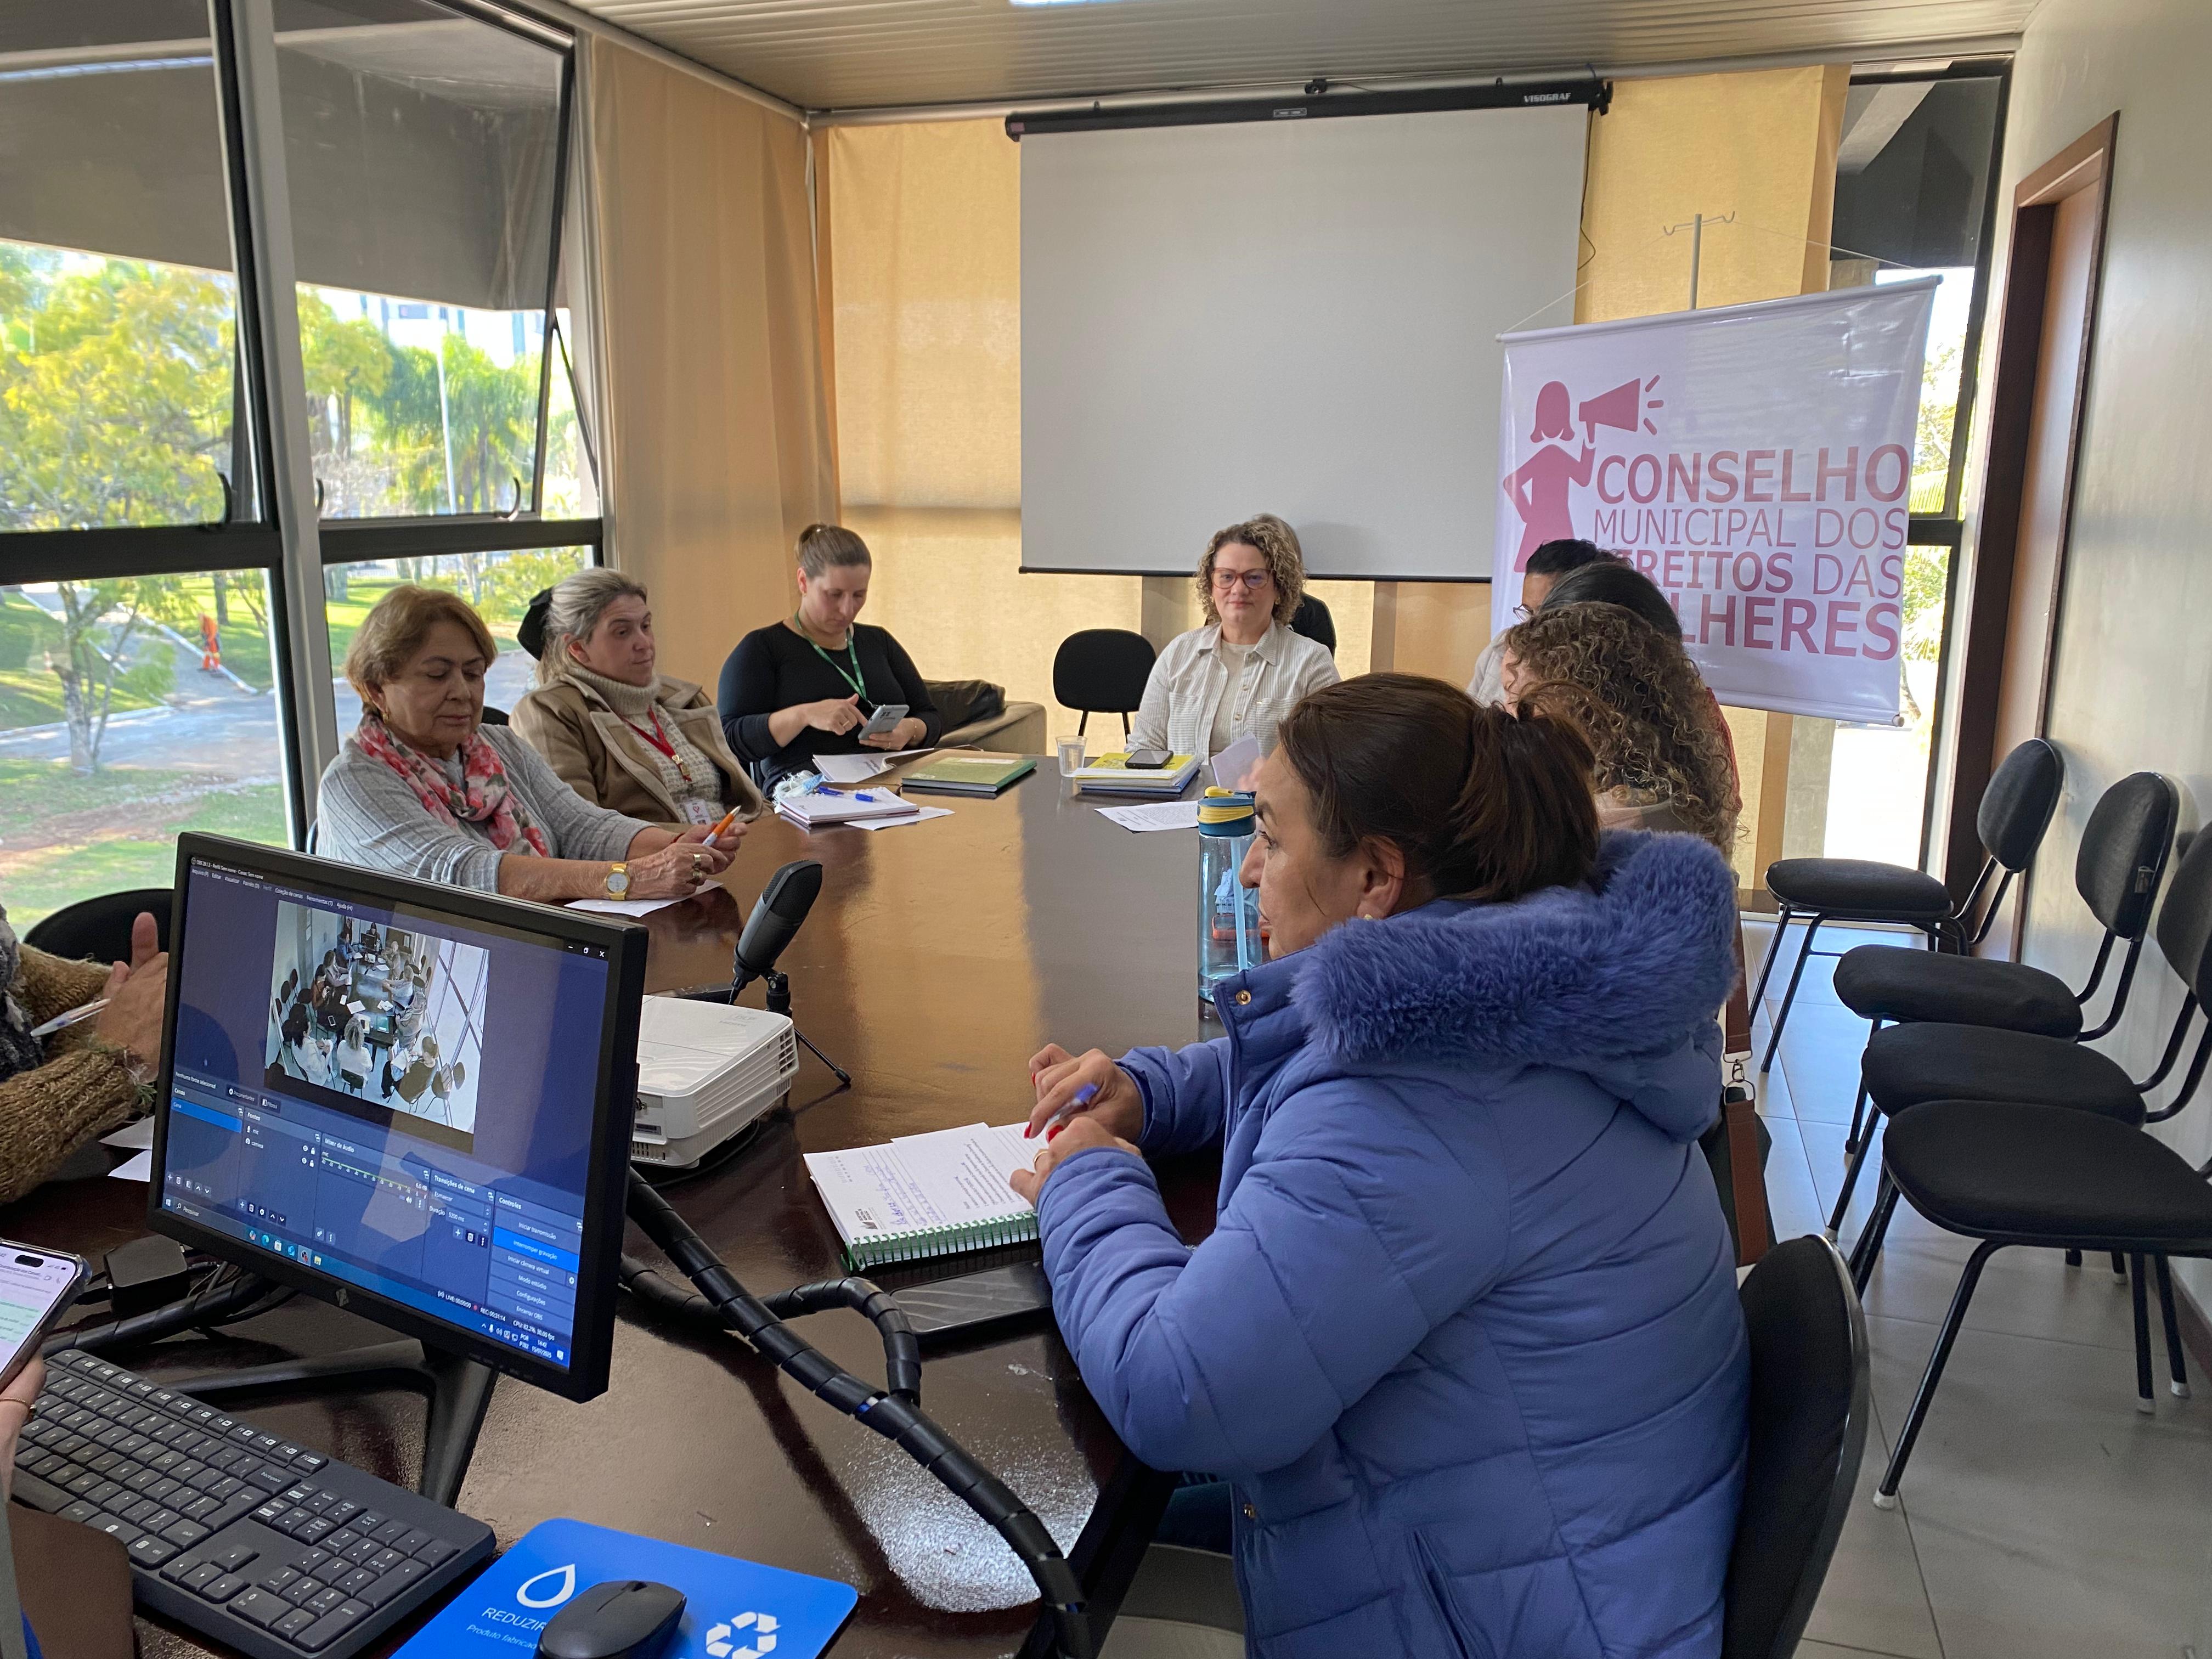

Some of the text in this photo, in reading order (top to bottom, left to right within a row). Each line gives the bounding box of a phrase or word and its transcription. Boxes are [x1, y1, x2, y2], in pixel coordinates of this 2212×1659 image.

[1524, 93, 1571, 103] VISOGRAF
[1597, 444, 1910, 504] CONSELHO
[1594, 507, 1905, 550] MUNICIPAL DOS
[1618, 549, 1903, 599] REITOS DAS
[1671, 592, 1899, 661] LHERES
[247, 1112, 261, 1121] Fontes
[434, 1175, 457, 1188] Transições
[464, 1186, 475, 1194] cena
[429, 1205, 445, 1216] Duração
[499, 1197, 522, 1210] Controles
[507, 1255, 549, 1275] Iniciar câmera virtual
[518, 1274, 547, 1290] Modo estúdio
[516, 1290, 546, 1306] Configurações
[480, 1307, 489, 1316] REC:
[513, 1320, 523, 1328] CPU:
[261, 1471, 281, 1483] backspace
[481, 1607, 547, 1631] REDUZIR
[466, 1624, 501, 1639] Produto
